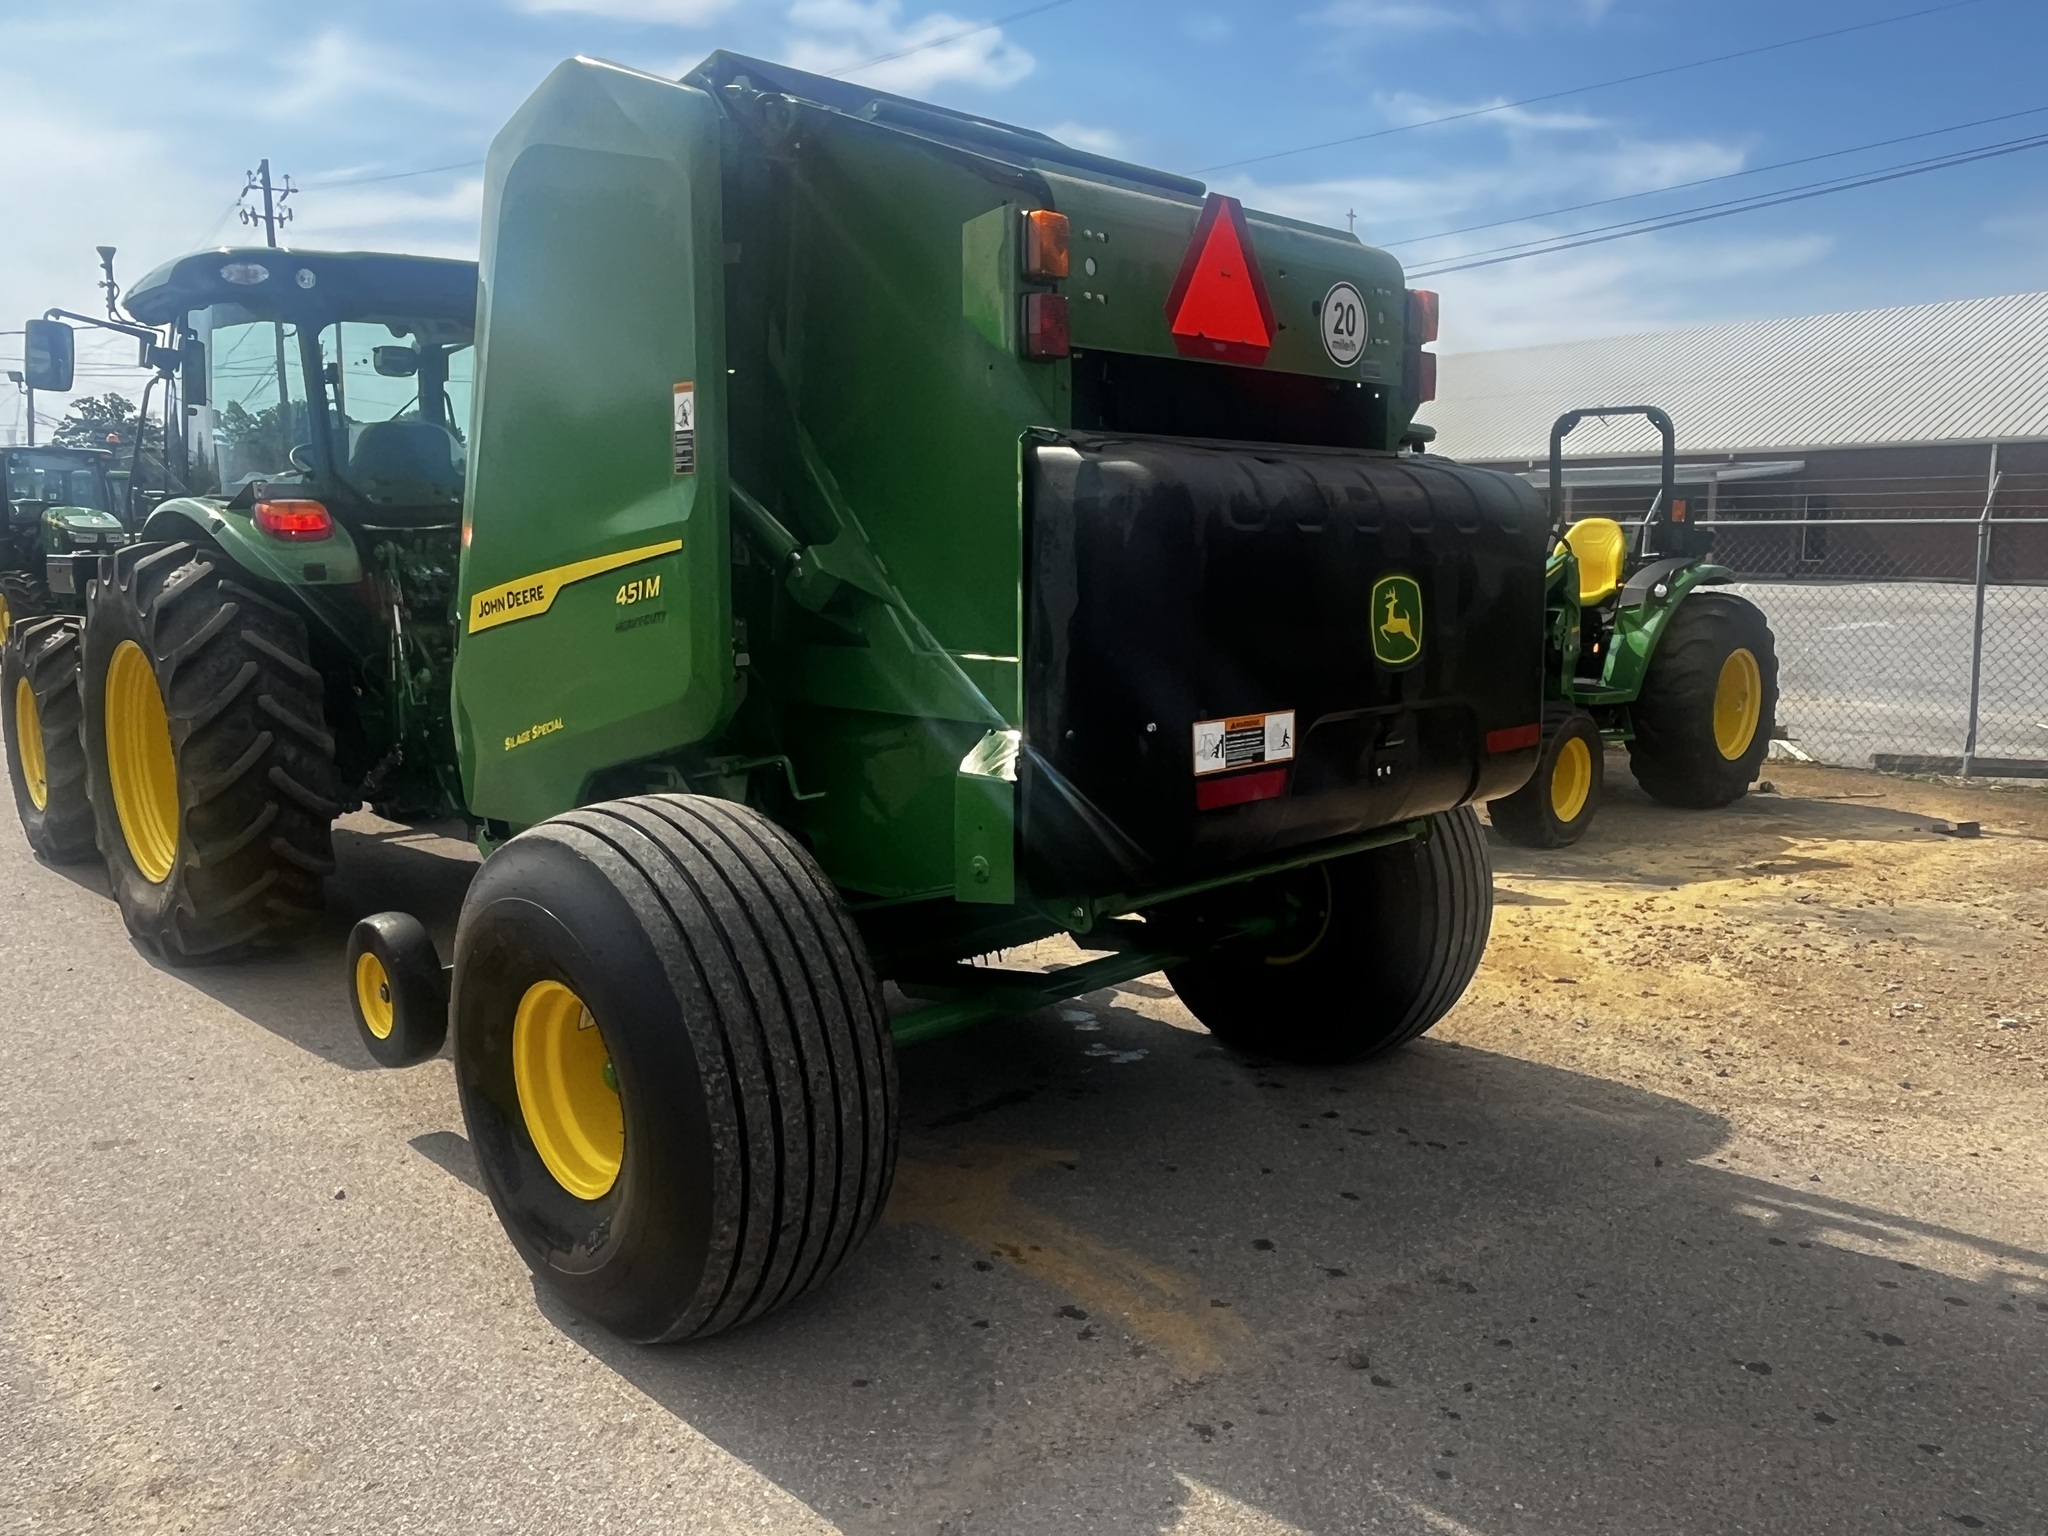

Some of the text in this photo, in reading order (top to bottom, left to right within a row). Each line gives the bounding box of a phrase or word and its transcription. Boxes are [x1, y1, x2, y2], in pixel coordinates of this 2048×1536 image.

[1333, 301, 1356, 337] 20
[478, 584, 545, 619] JOHN DEERE
[531, 717, 564, 740] SPECIAL
